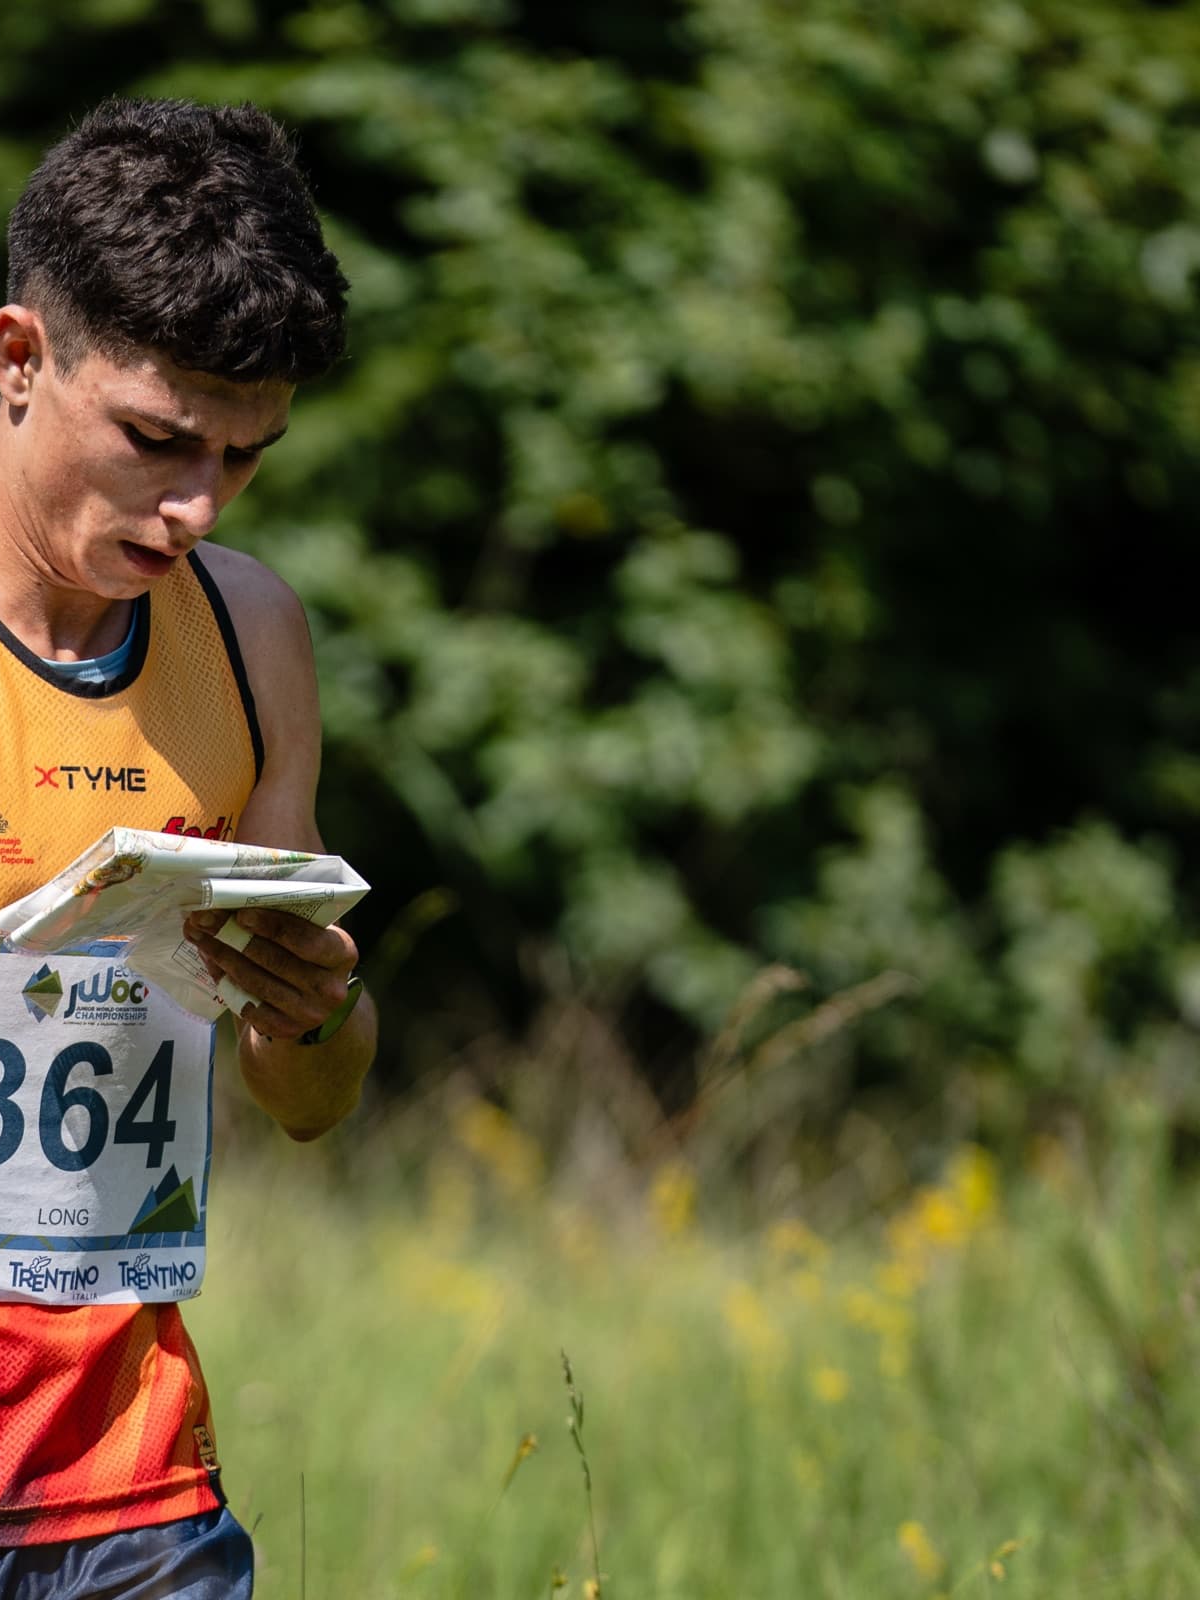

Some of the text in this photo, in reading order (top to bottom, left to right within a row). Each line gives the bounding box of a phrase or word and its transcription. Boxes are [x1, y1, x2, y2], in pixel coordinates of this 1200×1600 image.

[34, 765, 146, 792] XTYME
[1, 855, 35, 865] Deportes
[75, 1011, 148, 1020] CHAMPIONSHIPS
[38, 1208, 90, 1226] LONG
[9, 1261, 99, 1292] TRENTINO
[118, 1260, 197, 1290] TRENTINO
[72, 1290, 99, 1300] ITALIA
